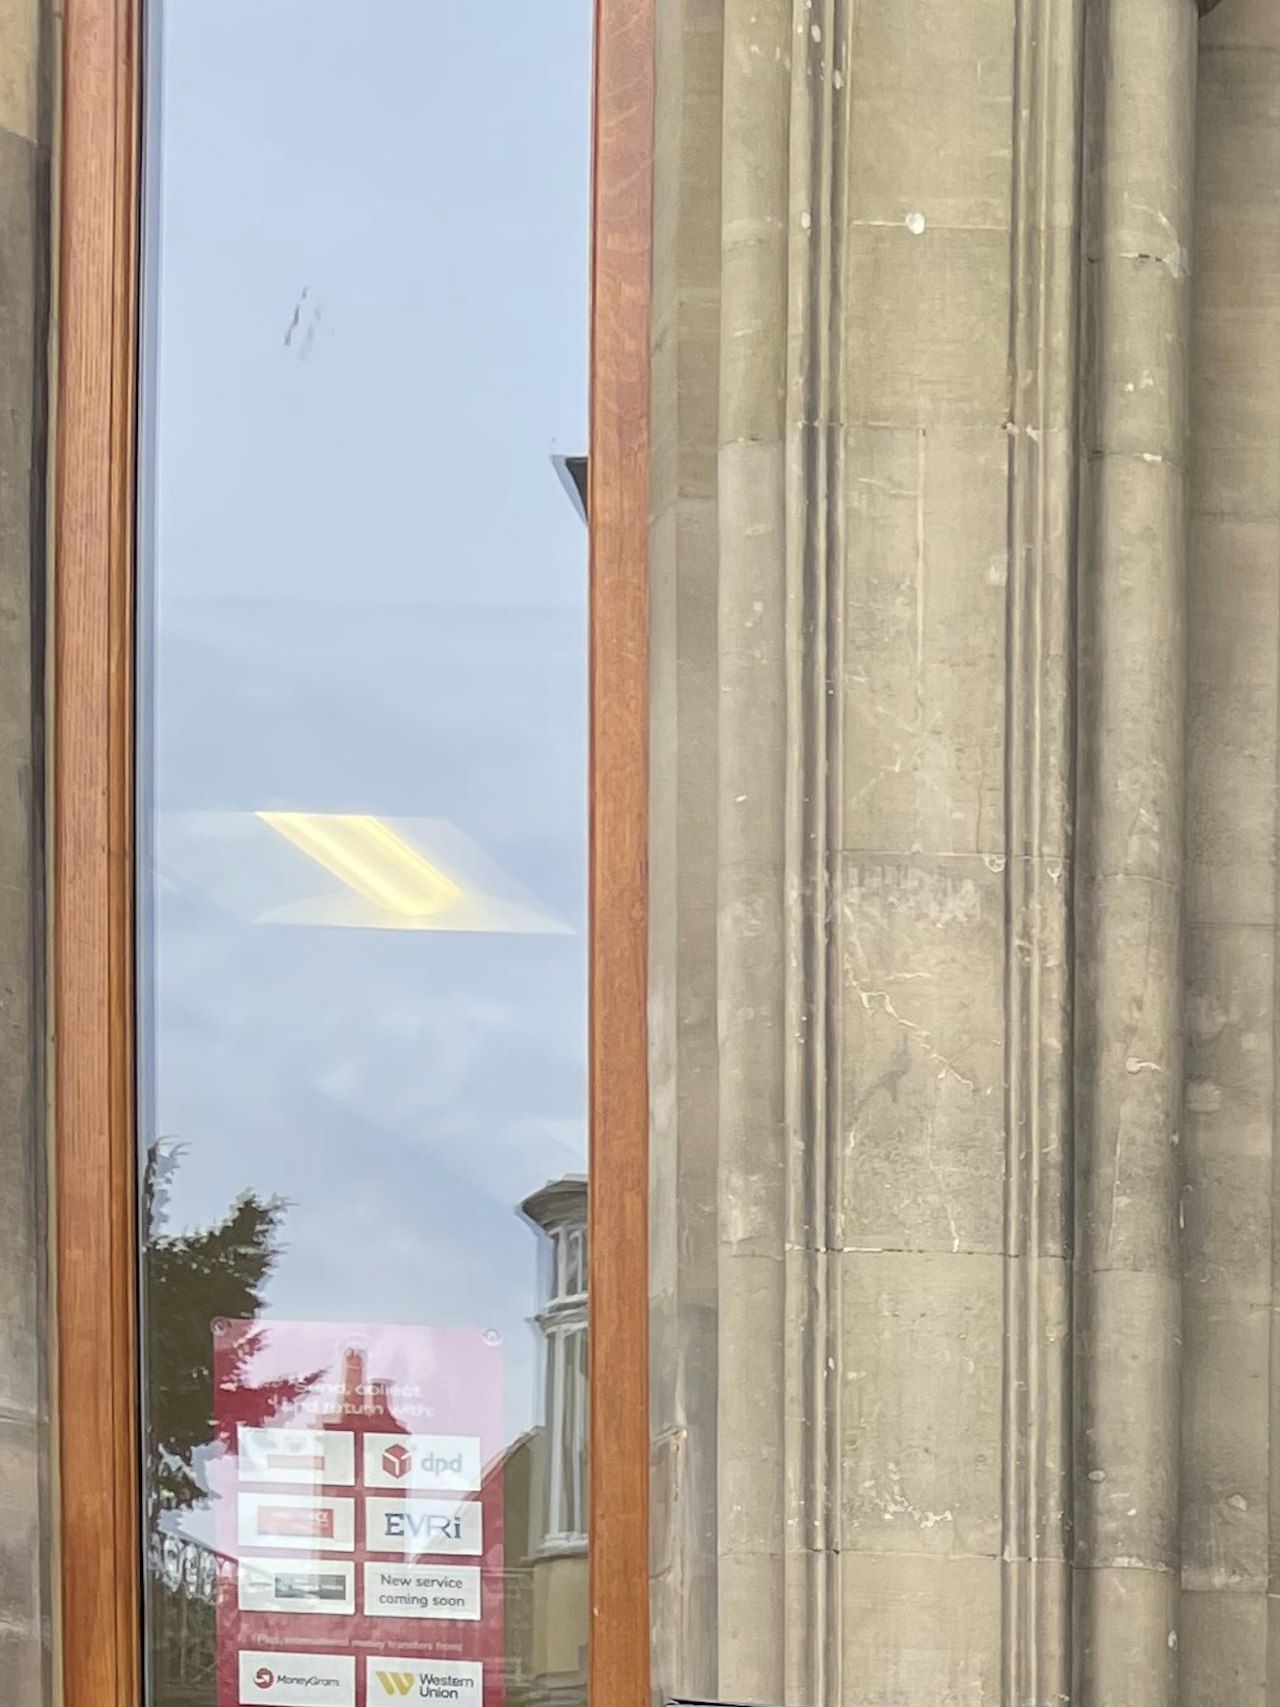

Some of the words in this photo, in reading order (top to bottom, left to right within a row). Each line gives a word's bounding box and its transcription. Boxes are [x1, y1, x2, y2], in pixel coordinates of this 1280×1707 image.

[421, 1452, 462, 1475] dpd
[381, 1574, 411, 1588] New
[415, 1576, 463, 1588] service
[379, 1593, 428, 1608] coming
[432, 1596, 465, 1608] soon
[418, 1673, 474, 1688] Western
[420, 1687, 458, 1700] Union
